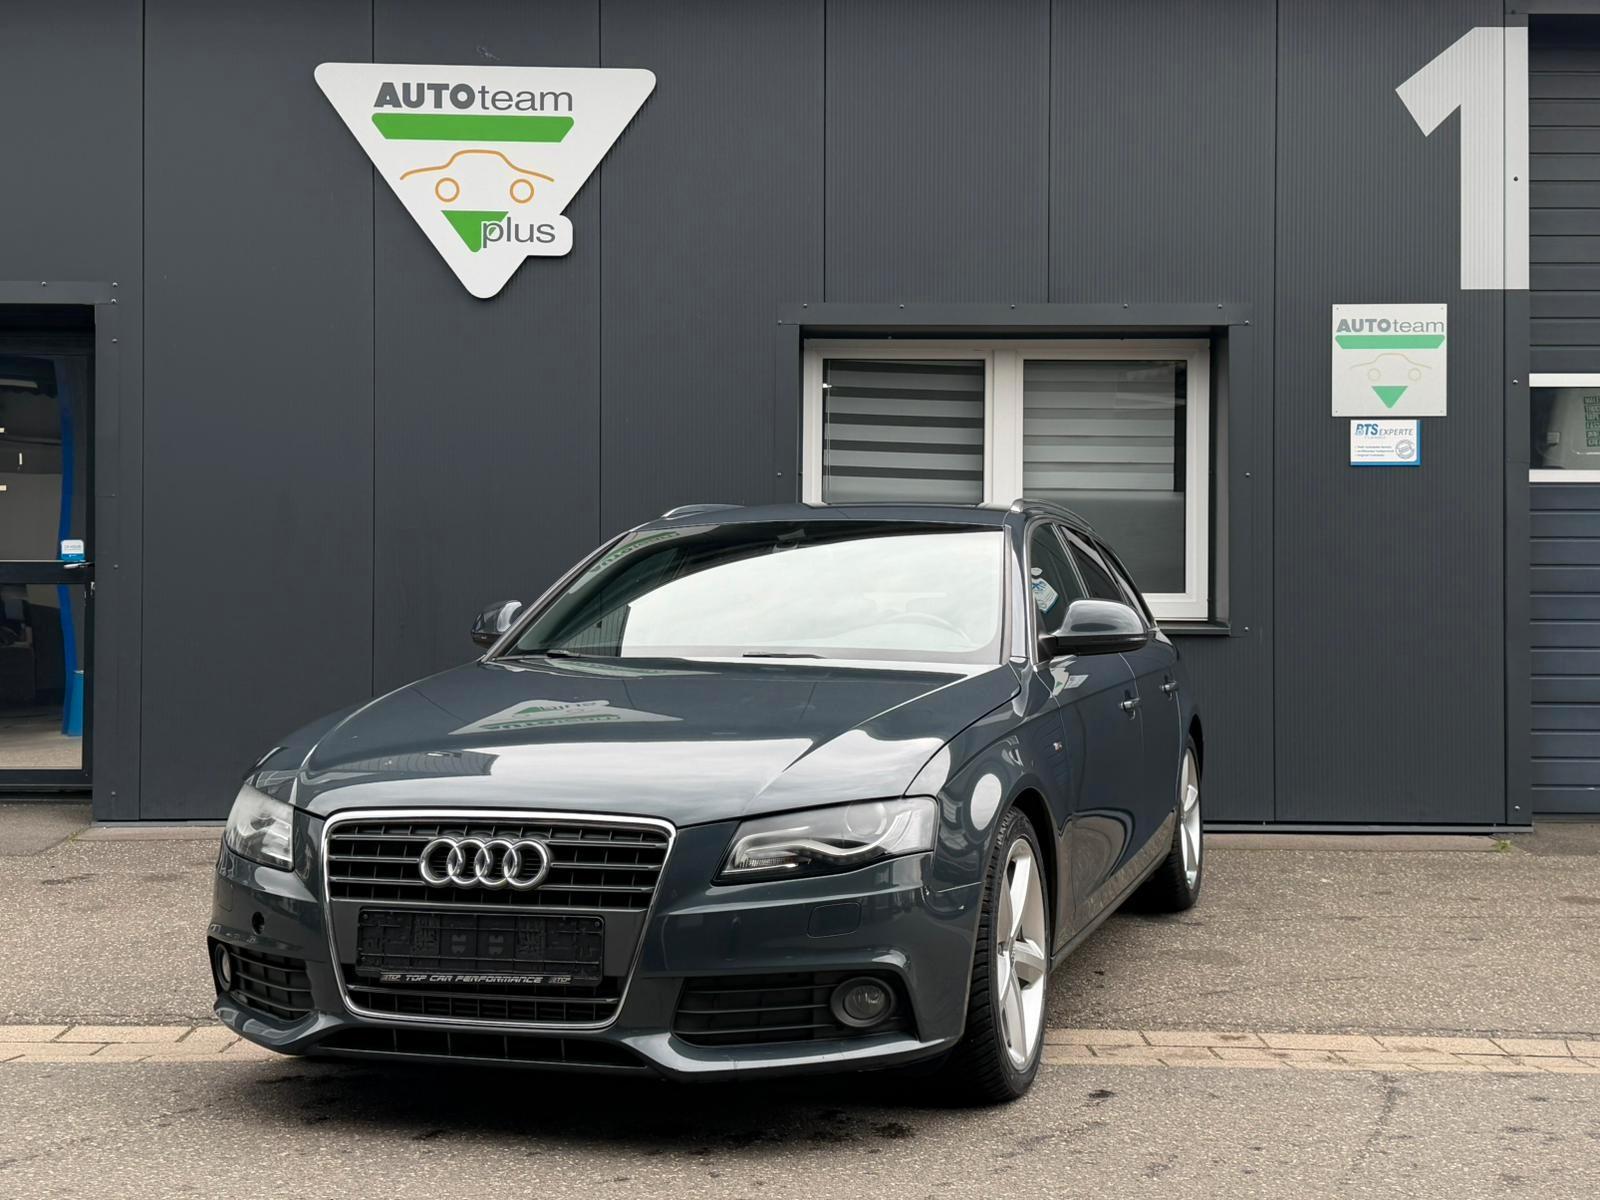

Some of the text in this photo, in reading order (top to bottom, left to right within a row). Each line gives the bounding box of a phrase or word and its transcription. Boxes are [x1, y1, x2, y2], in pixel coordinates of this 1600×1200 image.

[373, 81, 574, 112] AUTOteam
[1395, 26, 1530, 290] 1
[481, 216, 556, 249] plus
[1336, 318, 1445, 333] AUTOteam
[1355, 423, 1414, 436] BTS EXPERTE
[405, 974, 428, 982] TOP
[454, 975, 544, 984] PERFORMANCE
